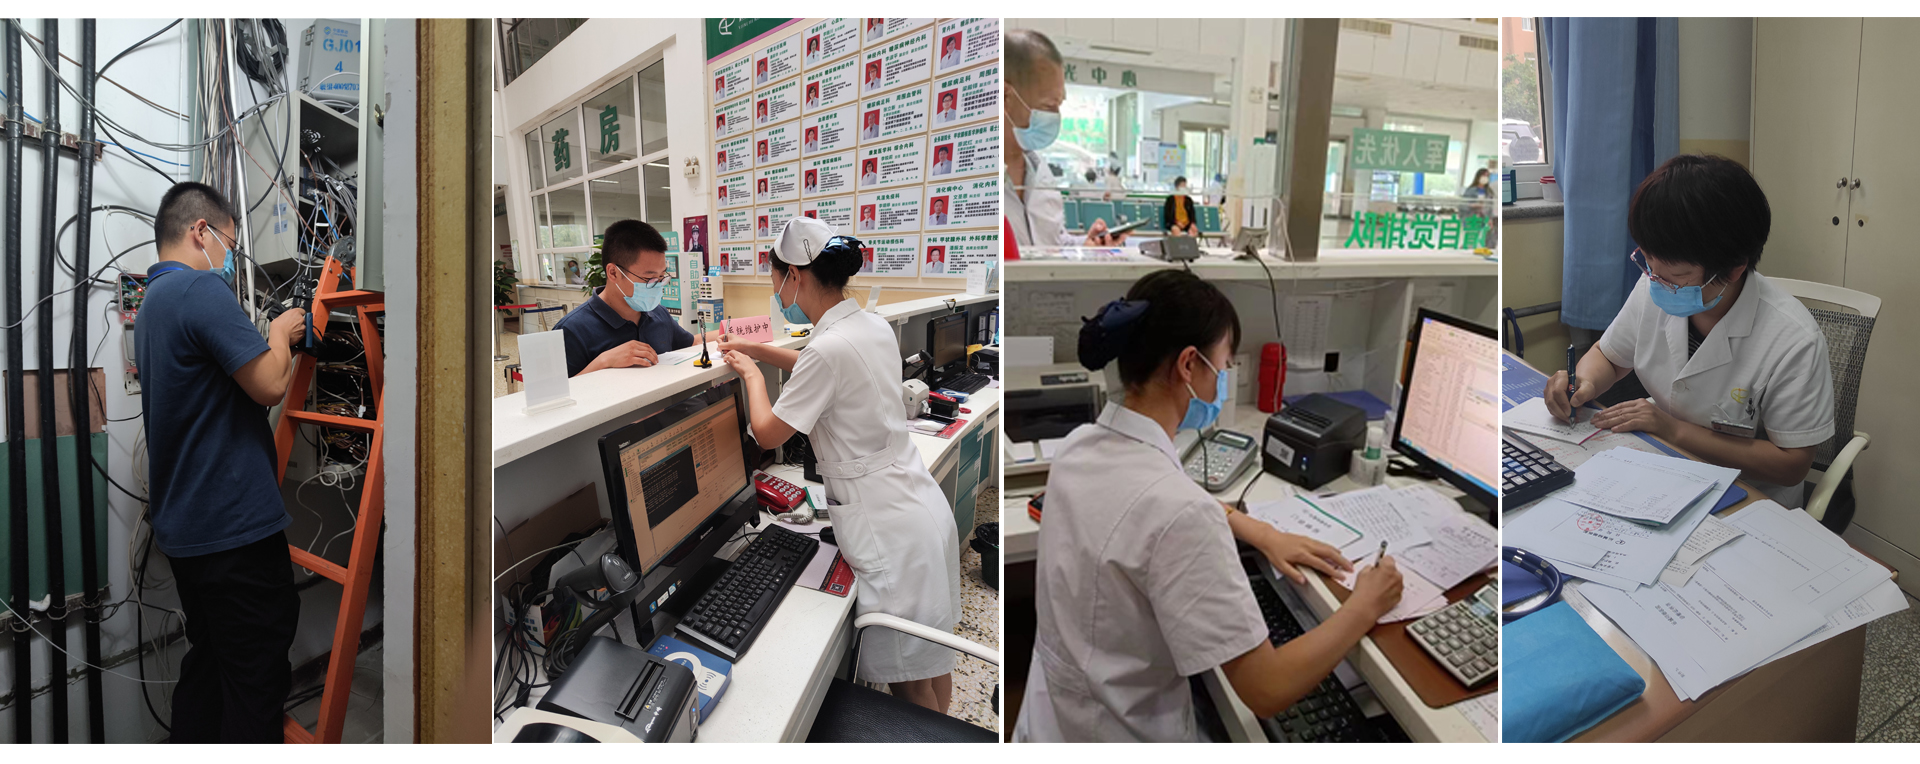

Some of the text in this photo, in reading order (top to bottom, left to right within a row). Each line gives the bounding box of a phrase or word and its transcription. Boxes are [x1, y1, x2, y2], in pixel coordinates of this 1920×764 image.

[867, 34, 927, 60] 神经内科 糖尿病神经内科
[335, 61, 344, 73] 4
[941, 67, 998, 88] 糖尿病足科 周围血
[866, 89, 922, 109] 糖尿病足科 周围血管科
[552, 104, 620, 172] 药房
[869, 146, 892, 155] 康复医学科
[936, 180, 998, 194] 消化病中心 消化内科
[876, 193, 900, 201] 风湿免疫科
[868, 238, 904, 246] 骨关节运动损伤科
